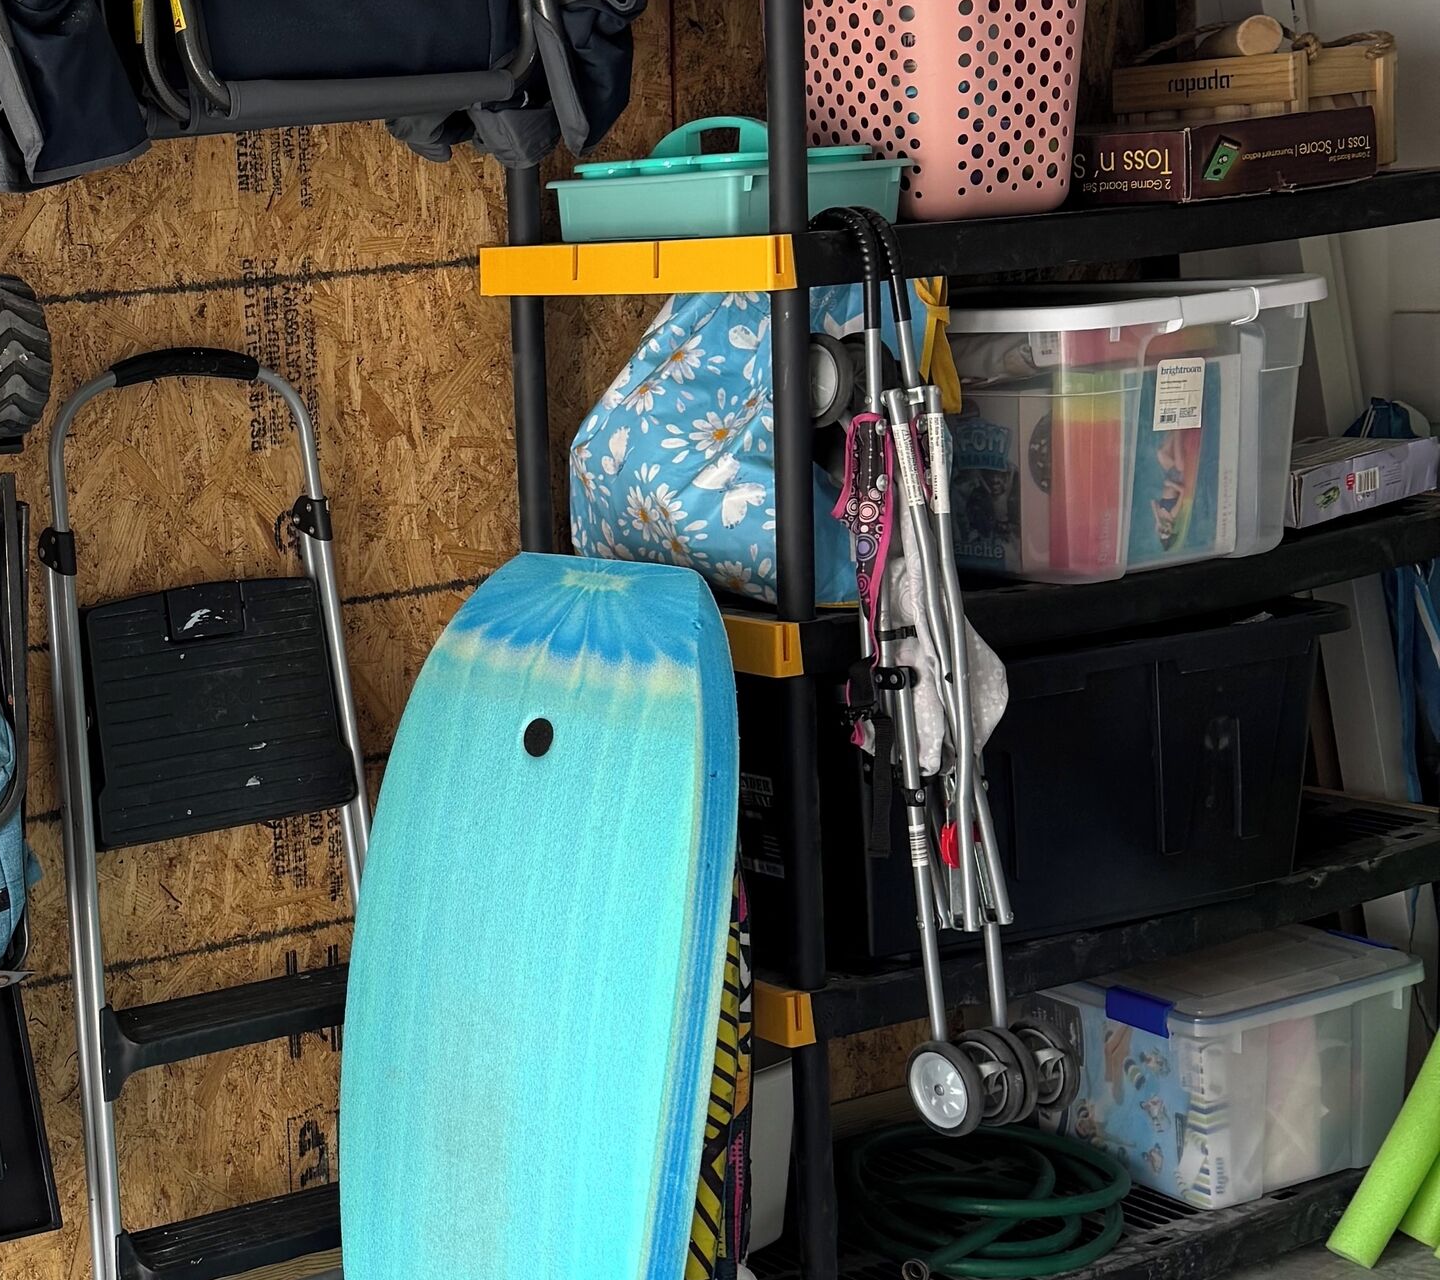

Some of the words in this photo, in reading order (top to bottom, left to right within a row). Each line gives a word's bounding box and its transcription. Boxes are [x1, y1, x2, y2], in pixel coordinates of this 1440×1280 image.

[1300, 140, 1332, 155] Score
[1348, 135, 1370, 150] Toss
[1123, 148, 1173, 175] Toss
[1242, 152, 1262, 160] edition
[1083, 182, 1097, 193] Set
[1100, 180, 1128, 192] Board
[1130, 179, 1163, 190] Game
[1165, 179, 1171, 190] 2
[1161, 366, 1201, 376] brightroom
